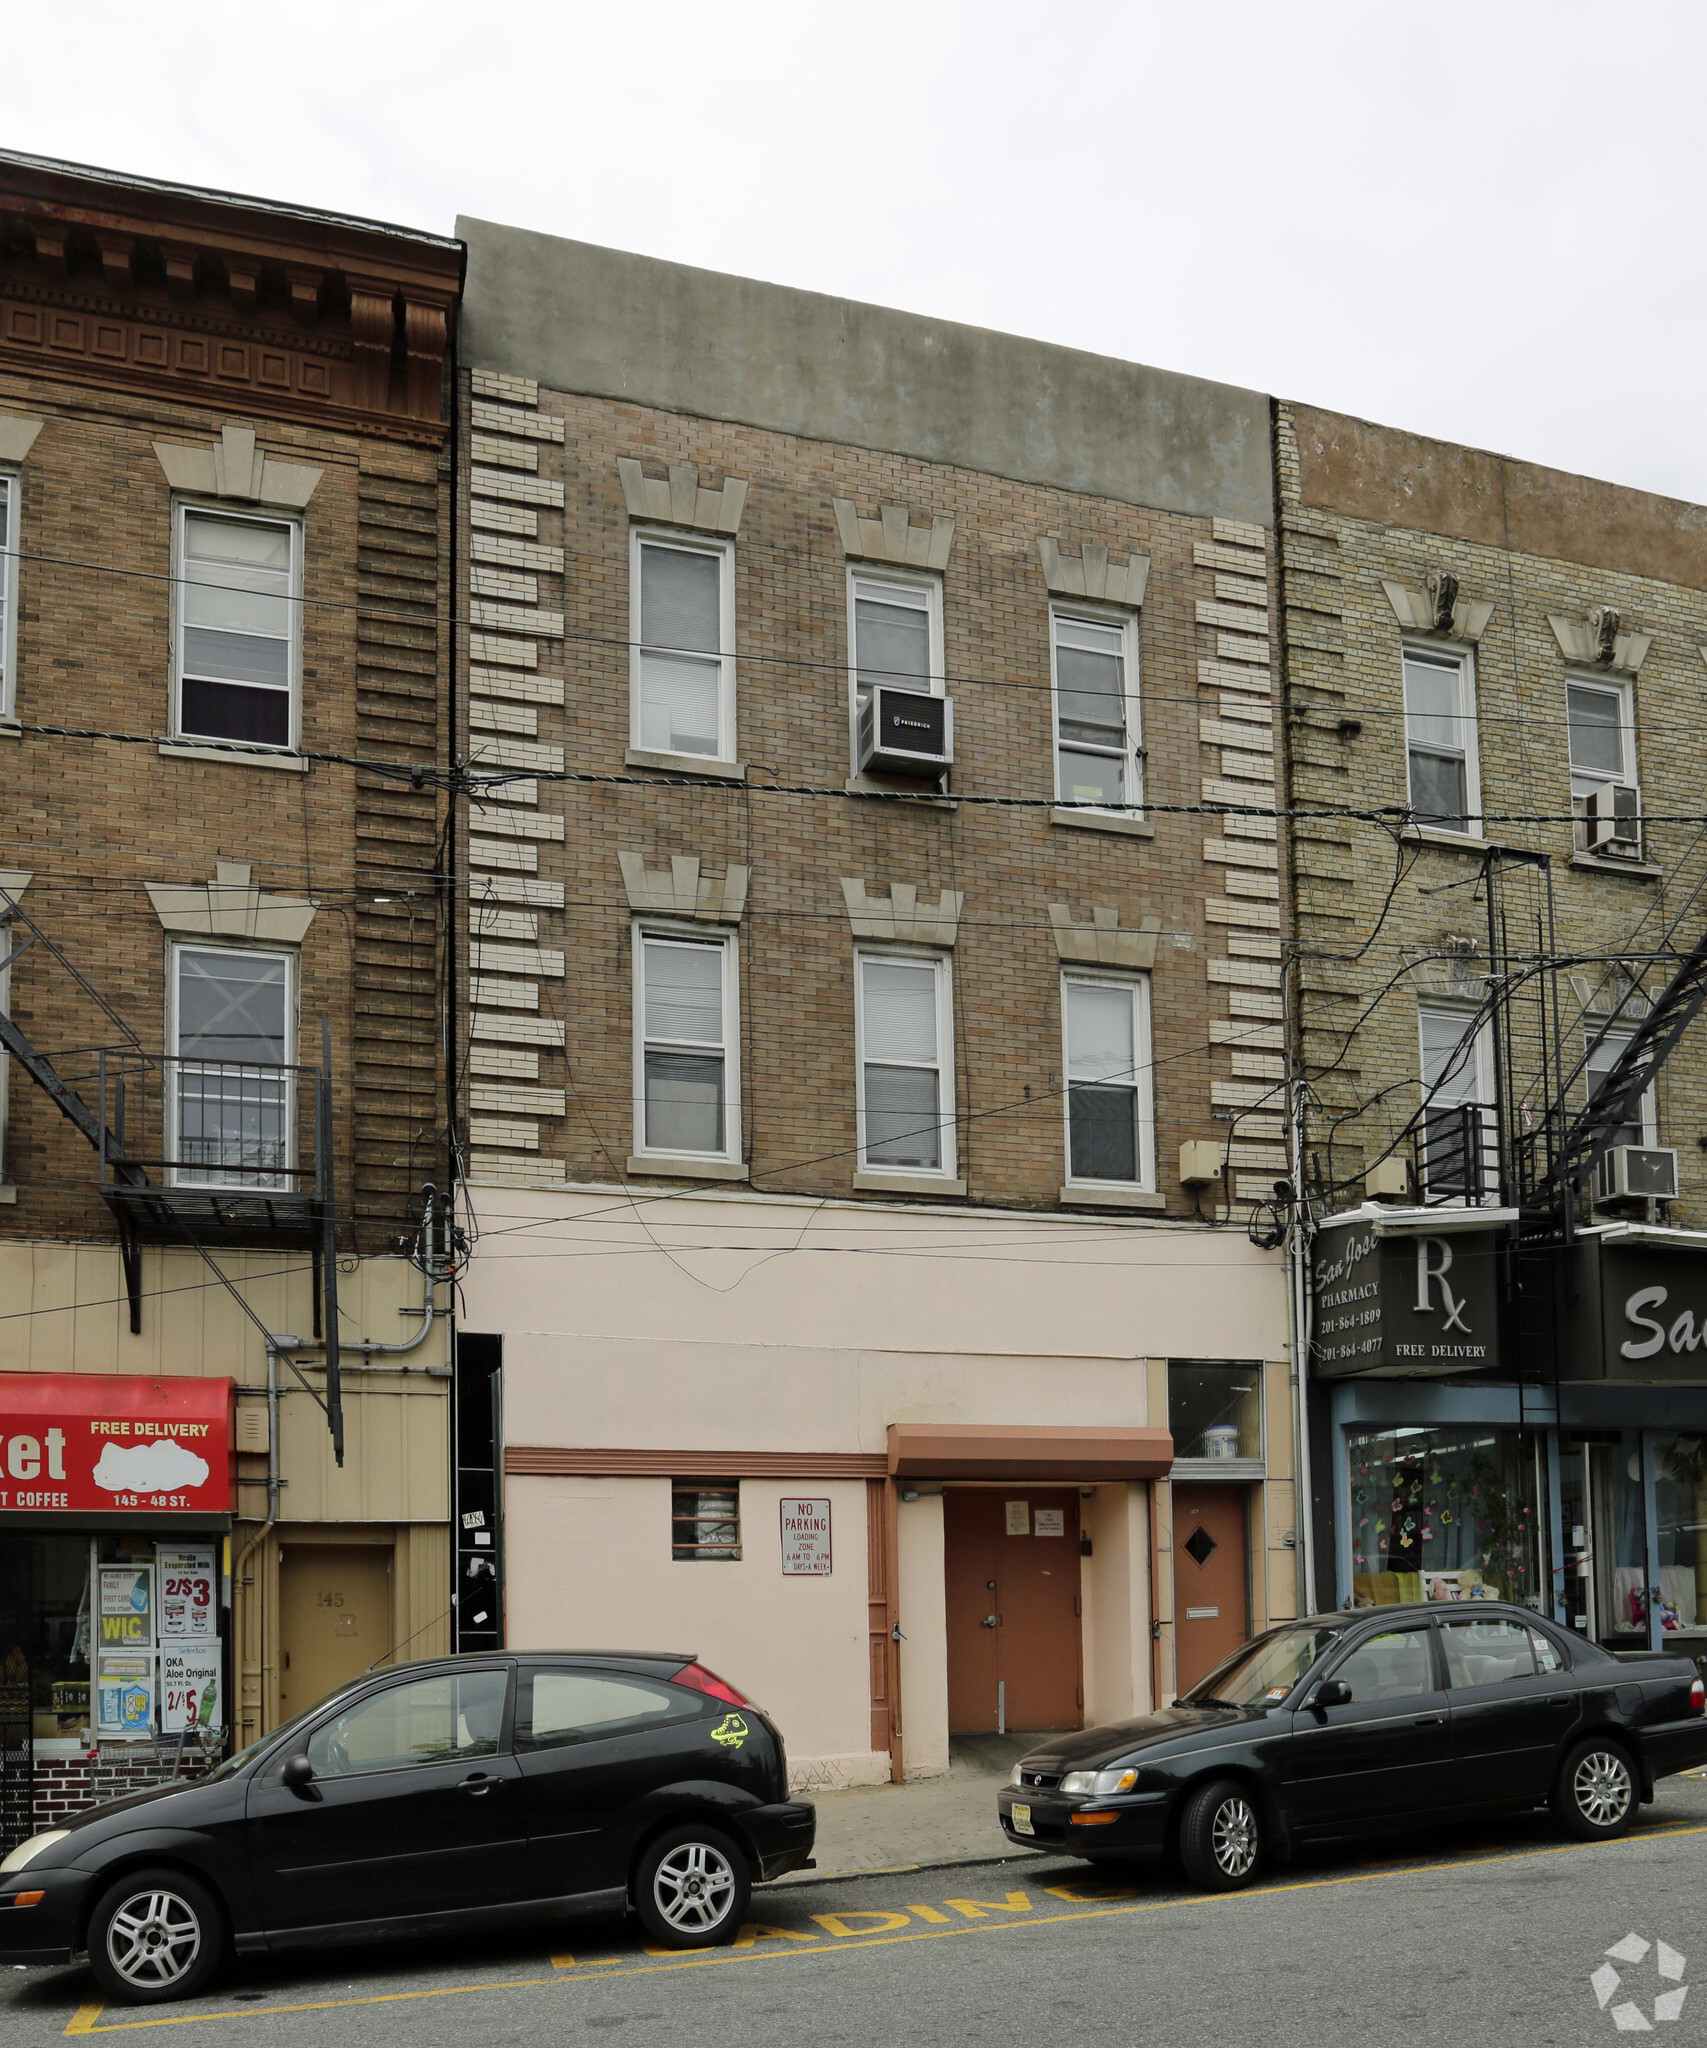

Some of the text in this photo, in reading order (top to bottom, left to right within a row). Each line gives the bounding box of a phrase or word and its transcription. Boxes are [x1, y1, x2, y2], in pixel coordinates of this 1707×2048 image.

[901, 719, 931, 729] FRIEDRICH
[1315, 1259, 1344, 1294] San
[1321, 1281, 1380, 1309] PHARMACY
[1321, 1308, 1381, 1335] 201-864-1809
[1620, 1286, 1707, 1359] Sa
[1321, 1337, 1383, 1361] 201-864-4077
[1396, 1344, 1487, 1357] FREE DELIVERY
[91, 1421, 209, 1437] FREE DELIVERY
[0, 1428, 66, 1480] et
[16, 1491, 68, 1508] COFFEE
[114, 1495, 138, 1507] 145
[150, 1496, 167, 1507] 48
[170, 1496, 190, 1508] ST.
[798, 1503, 813, 1516] NO
[785, 1518, 826, 1531] PARKING
[793, 1533, 819, 1541] LOADING
[798, 1543, 814, 1551] ZONE
[786, 1553, 791, 1561] 6
[792, 1553, 801, 1561] AM
[816, 1553, 820, 1561] 6
[821, 1553, 830, 1561] PM
[164, 1562, 196, 1570] Evaporated
[813, 1563, 827, 1571] WEEK
[103, 1581, 120, 1589] FAMILY
[103, 1595, 117, 1603] FIRST
[316, 1591, 344, 1608] 145
[102, 1617, 142, 1639] WIC
[165, 1657, 184, 1668] OKA
[166, 1667, 217, 1680] Aloe Original
